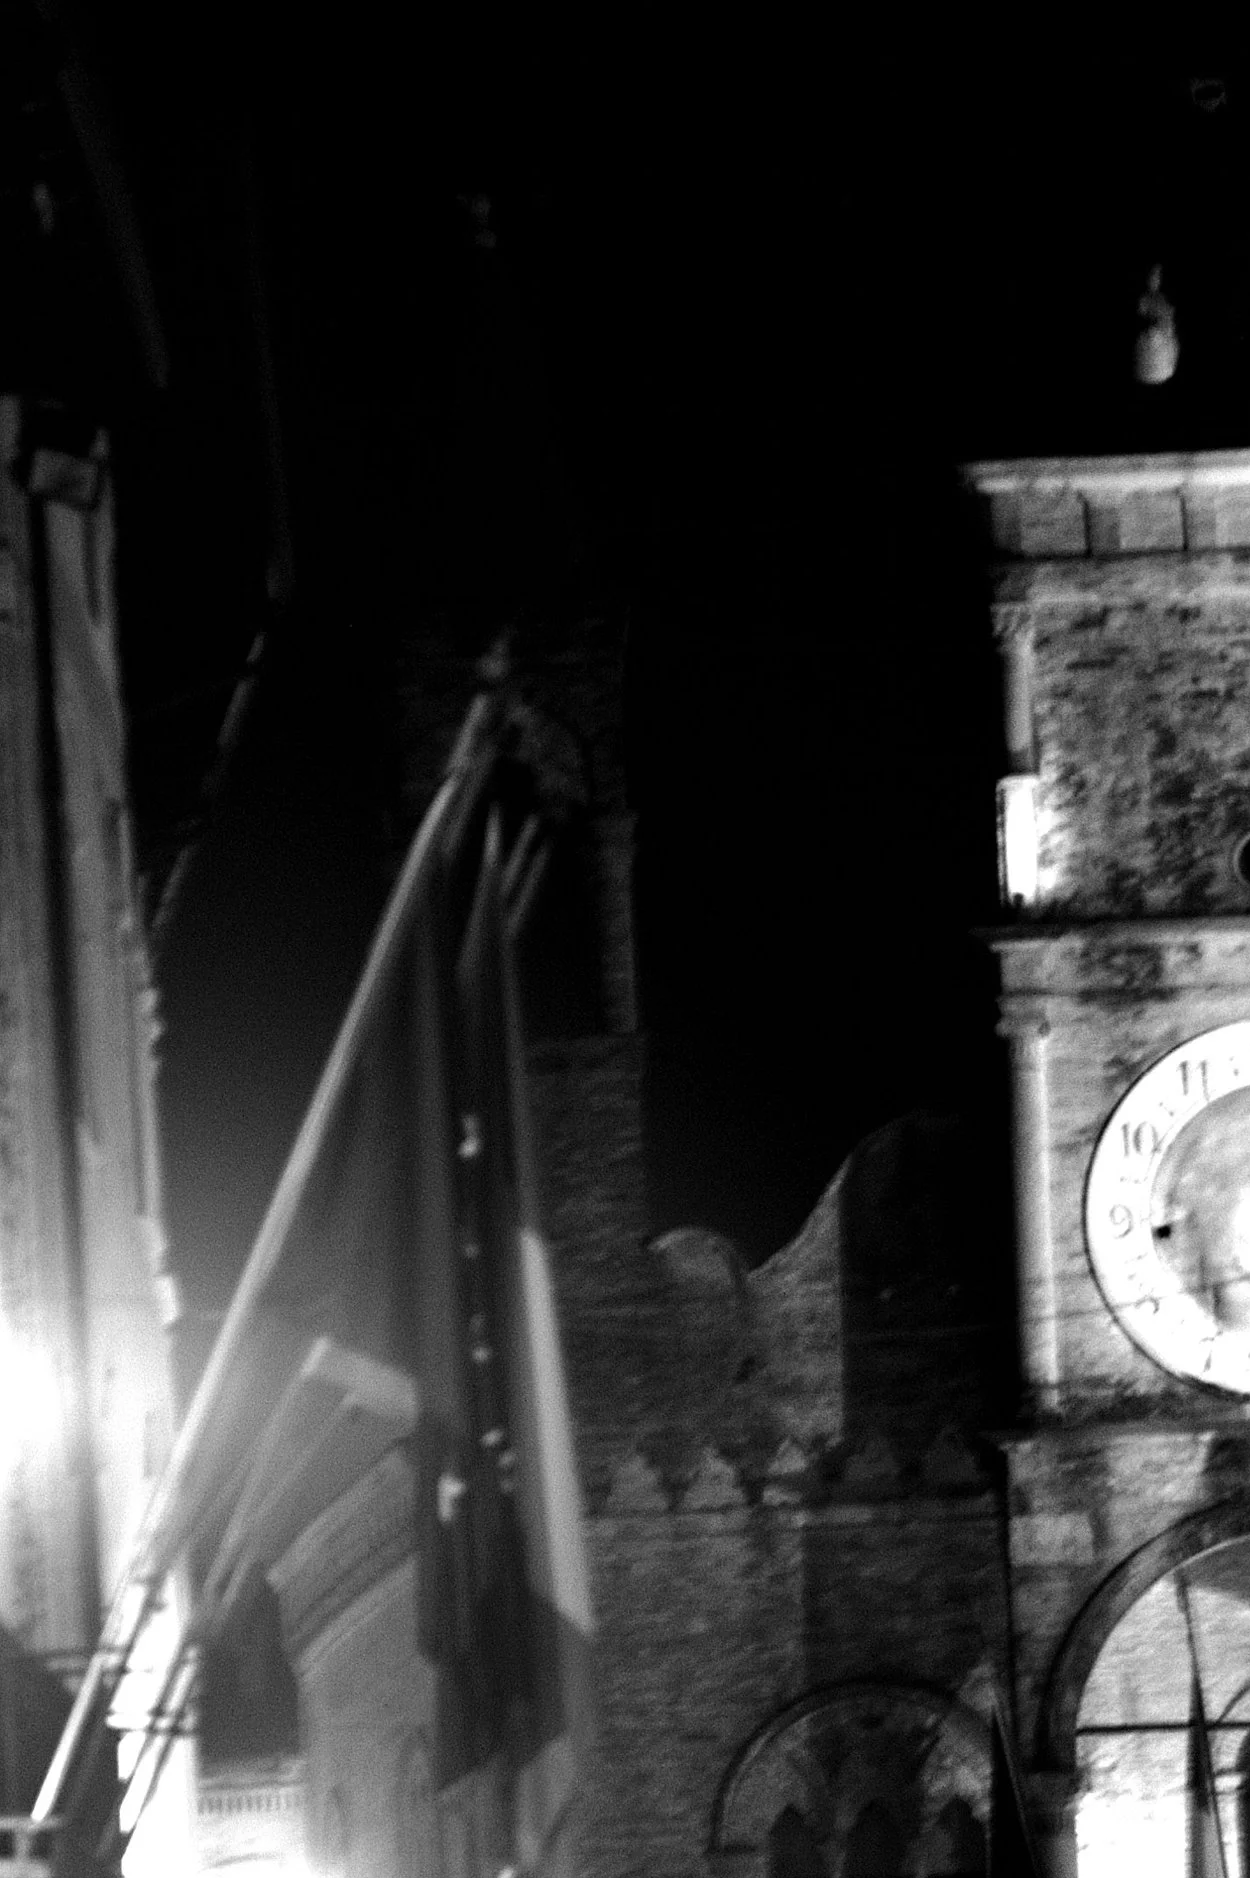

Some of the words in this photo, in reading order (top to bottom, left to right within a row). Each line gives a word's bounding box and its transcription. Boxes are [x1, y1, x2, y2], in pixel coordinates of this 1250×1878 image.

[1177, 1060, 1210, 1099] 11
[1120, 1121, 1160, 1157] 10
[1109, 1204, 1136, 1239] 9
